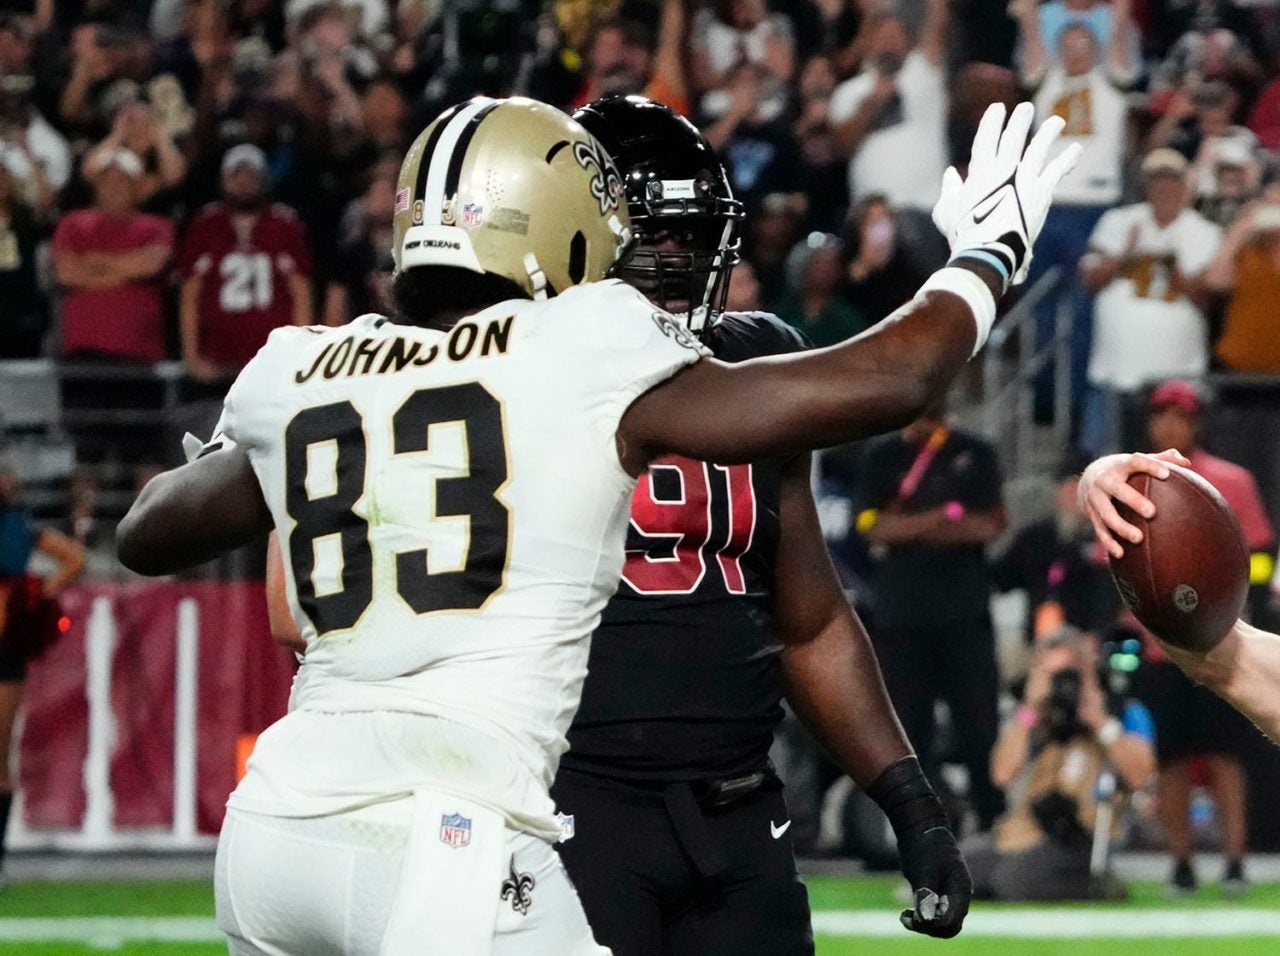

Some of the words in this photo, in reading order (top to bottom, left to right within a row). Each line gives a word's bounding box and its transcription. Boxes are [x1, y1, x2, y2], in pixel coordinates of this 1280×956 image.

[219, 251, 273, 312] 21
[284, 380, 514, 639] 83
[620, 455, 757, 595] 91
[444, 829, 468, 845] NFL
